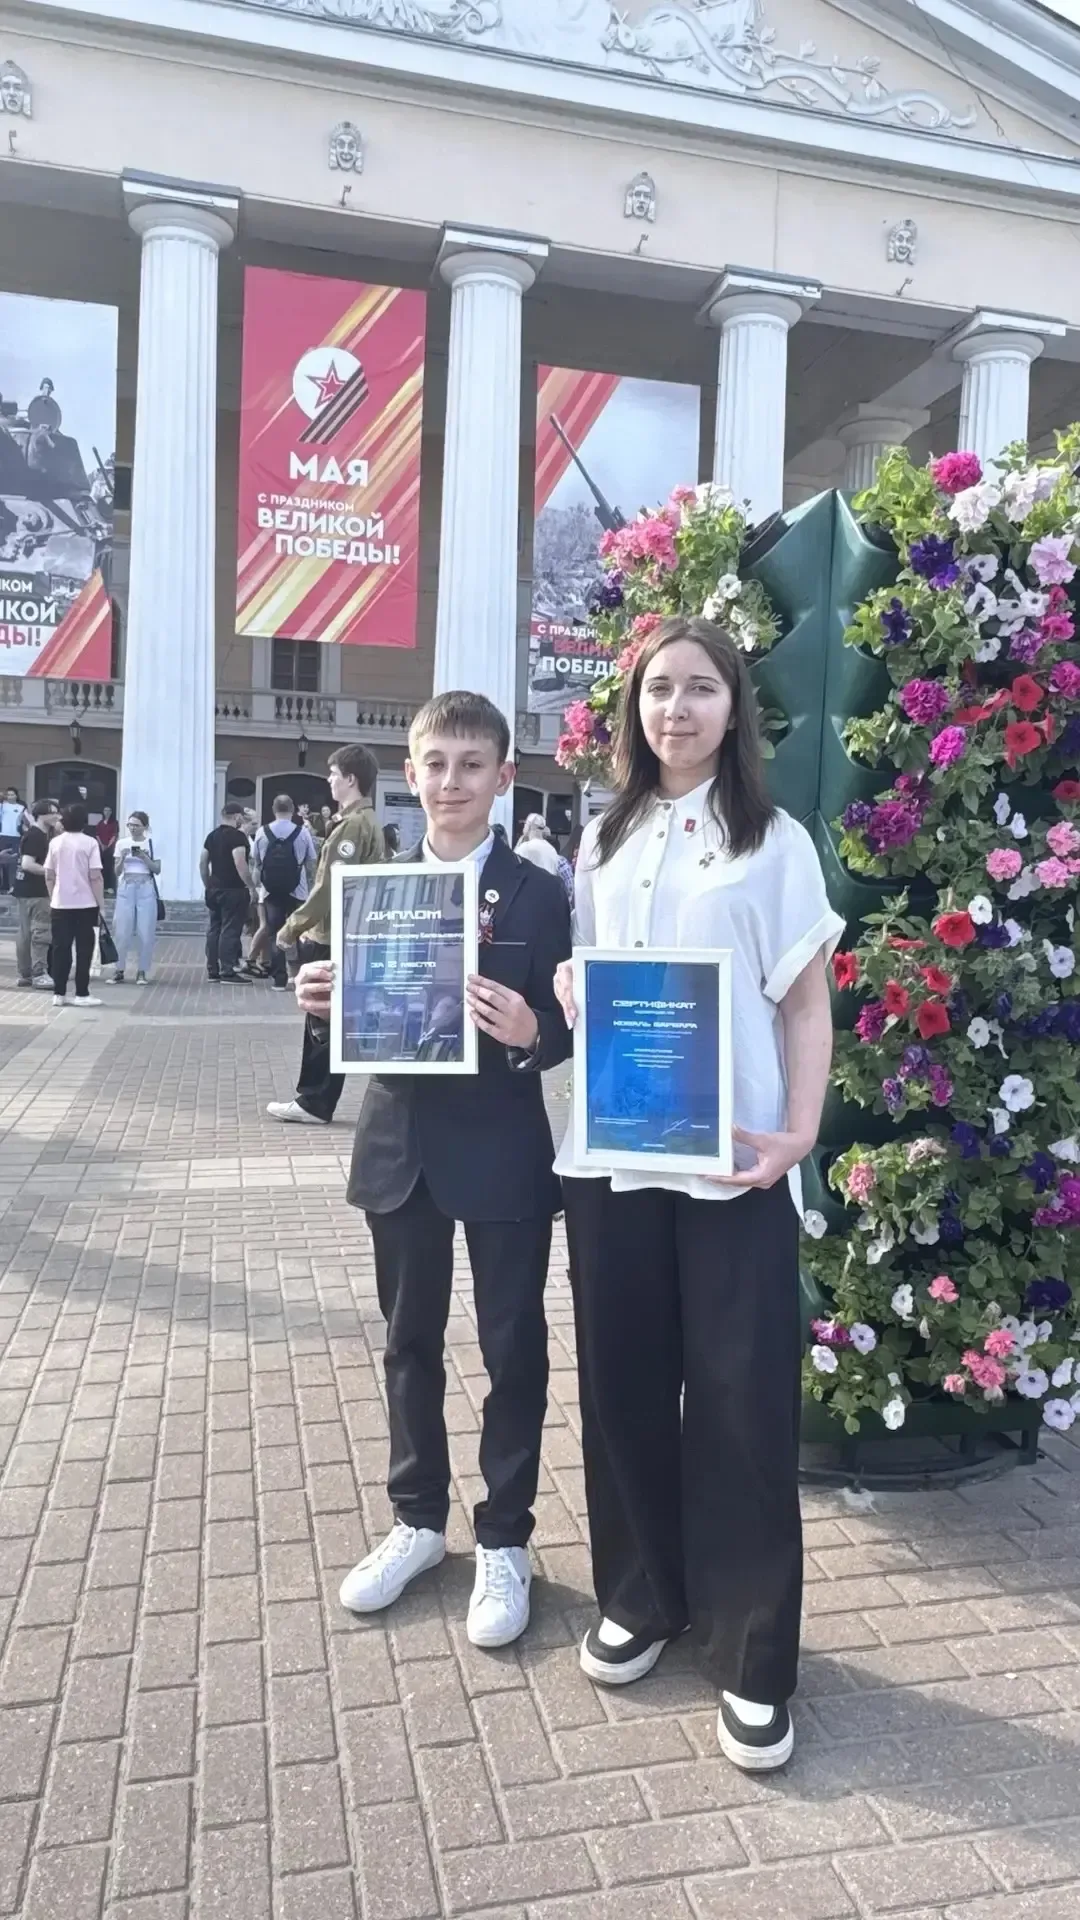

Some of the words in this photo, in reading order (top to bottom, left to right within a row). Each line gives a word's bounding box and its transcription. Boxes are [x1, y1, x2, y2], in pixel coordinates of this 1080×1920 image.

[289, 451, 369, 488] МАЯ
[257, 492, 268, 504] С
[270, 493, 355, 512] ПРАЗДНИКОМ
[257, 507, 385, 540] ВЕЛИКОЙ
[275, 534, 401, 565] ПОБЕДЫ!
[0, 578, 33, 593] КОМ
[537, 624, 547, 634] С
[549, 625, 598, 639] ПРАЗДН
